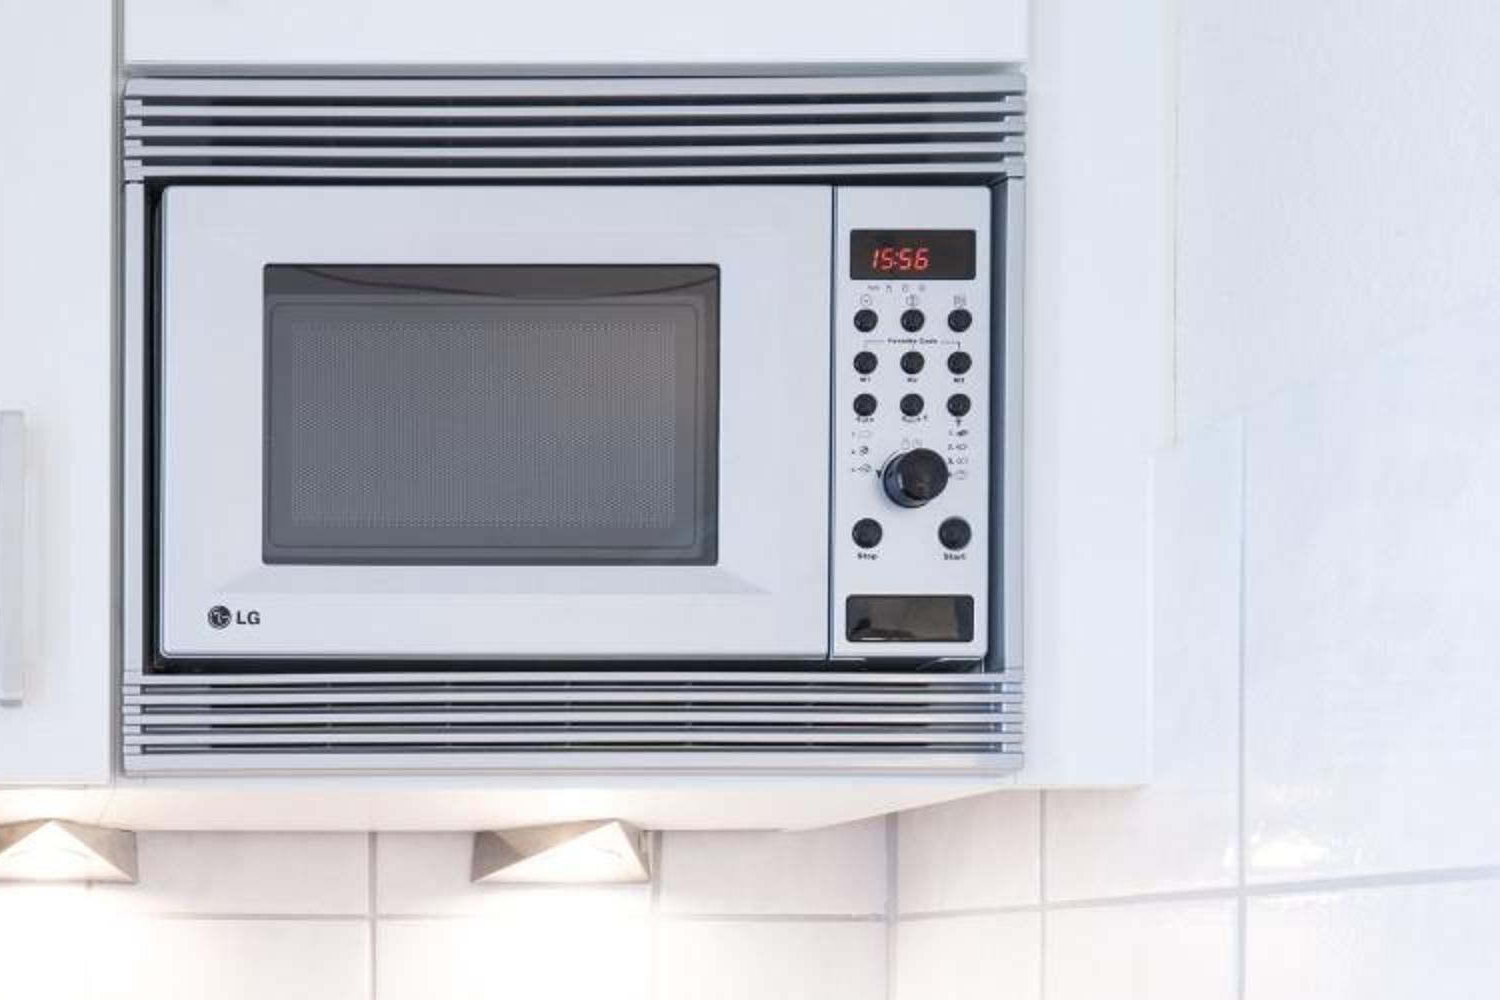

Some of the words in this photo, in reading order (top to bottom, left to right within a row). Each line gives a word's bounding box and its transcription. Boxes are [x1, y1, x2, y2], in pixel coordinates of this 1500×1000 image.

[873, 248, 928, 270] 15:56
[857, 552, 878, 560] Stop
[943, 552, 966, 560] Start
[236, 610, 261, 625] LG
